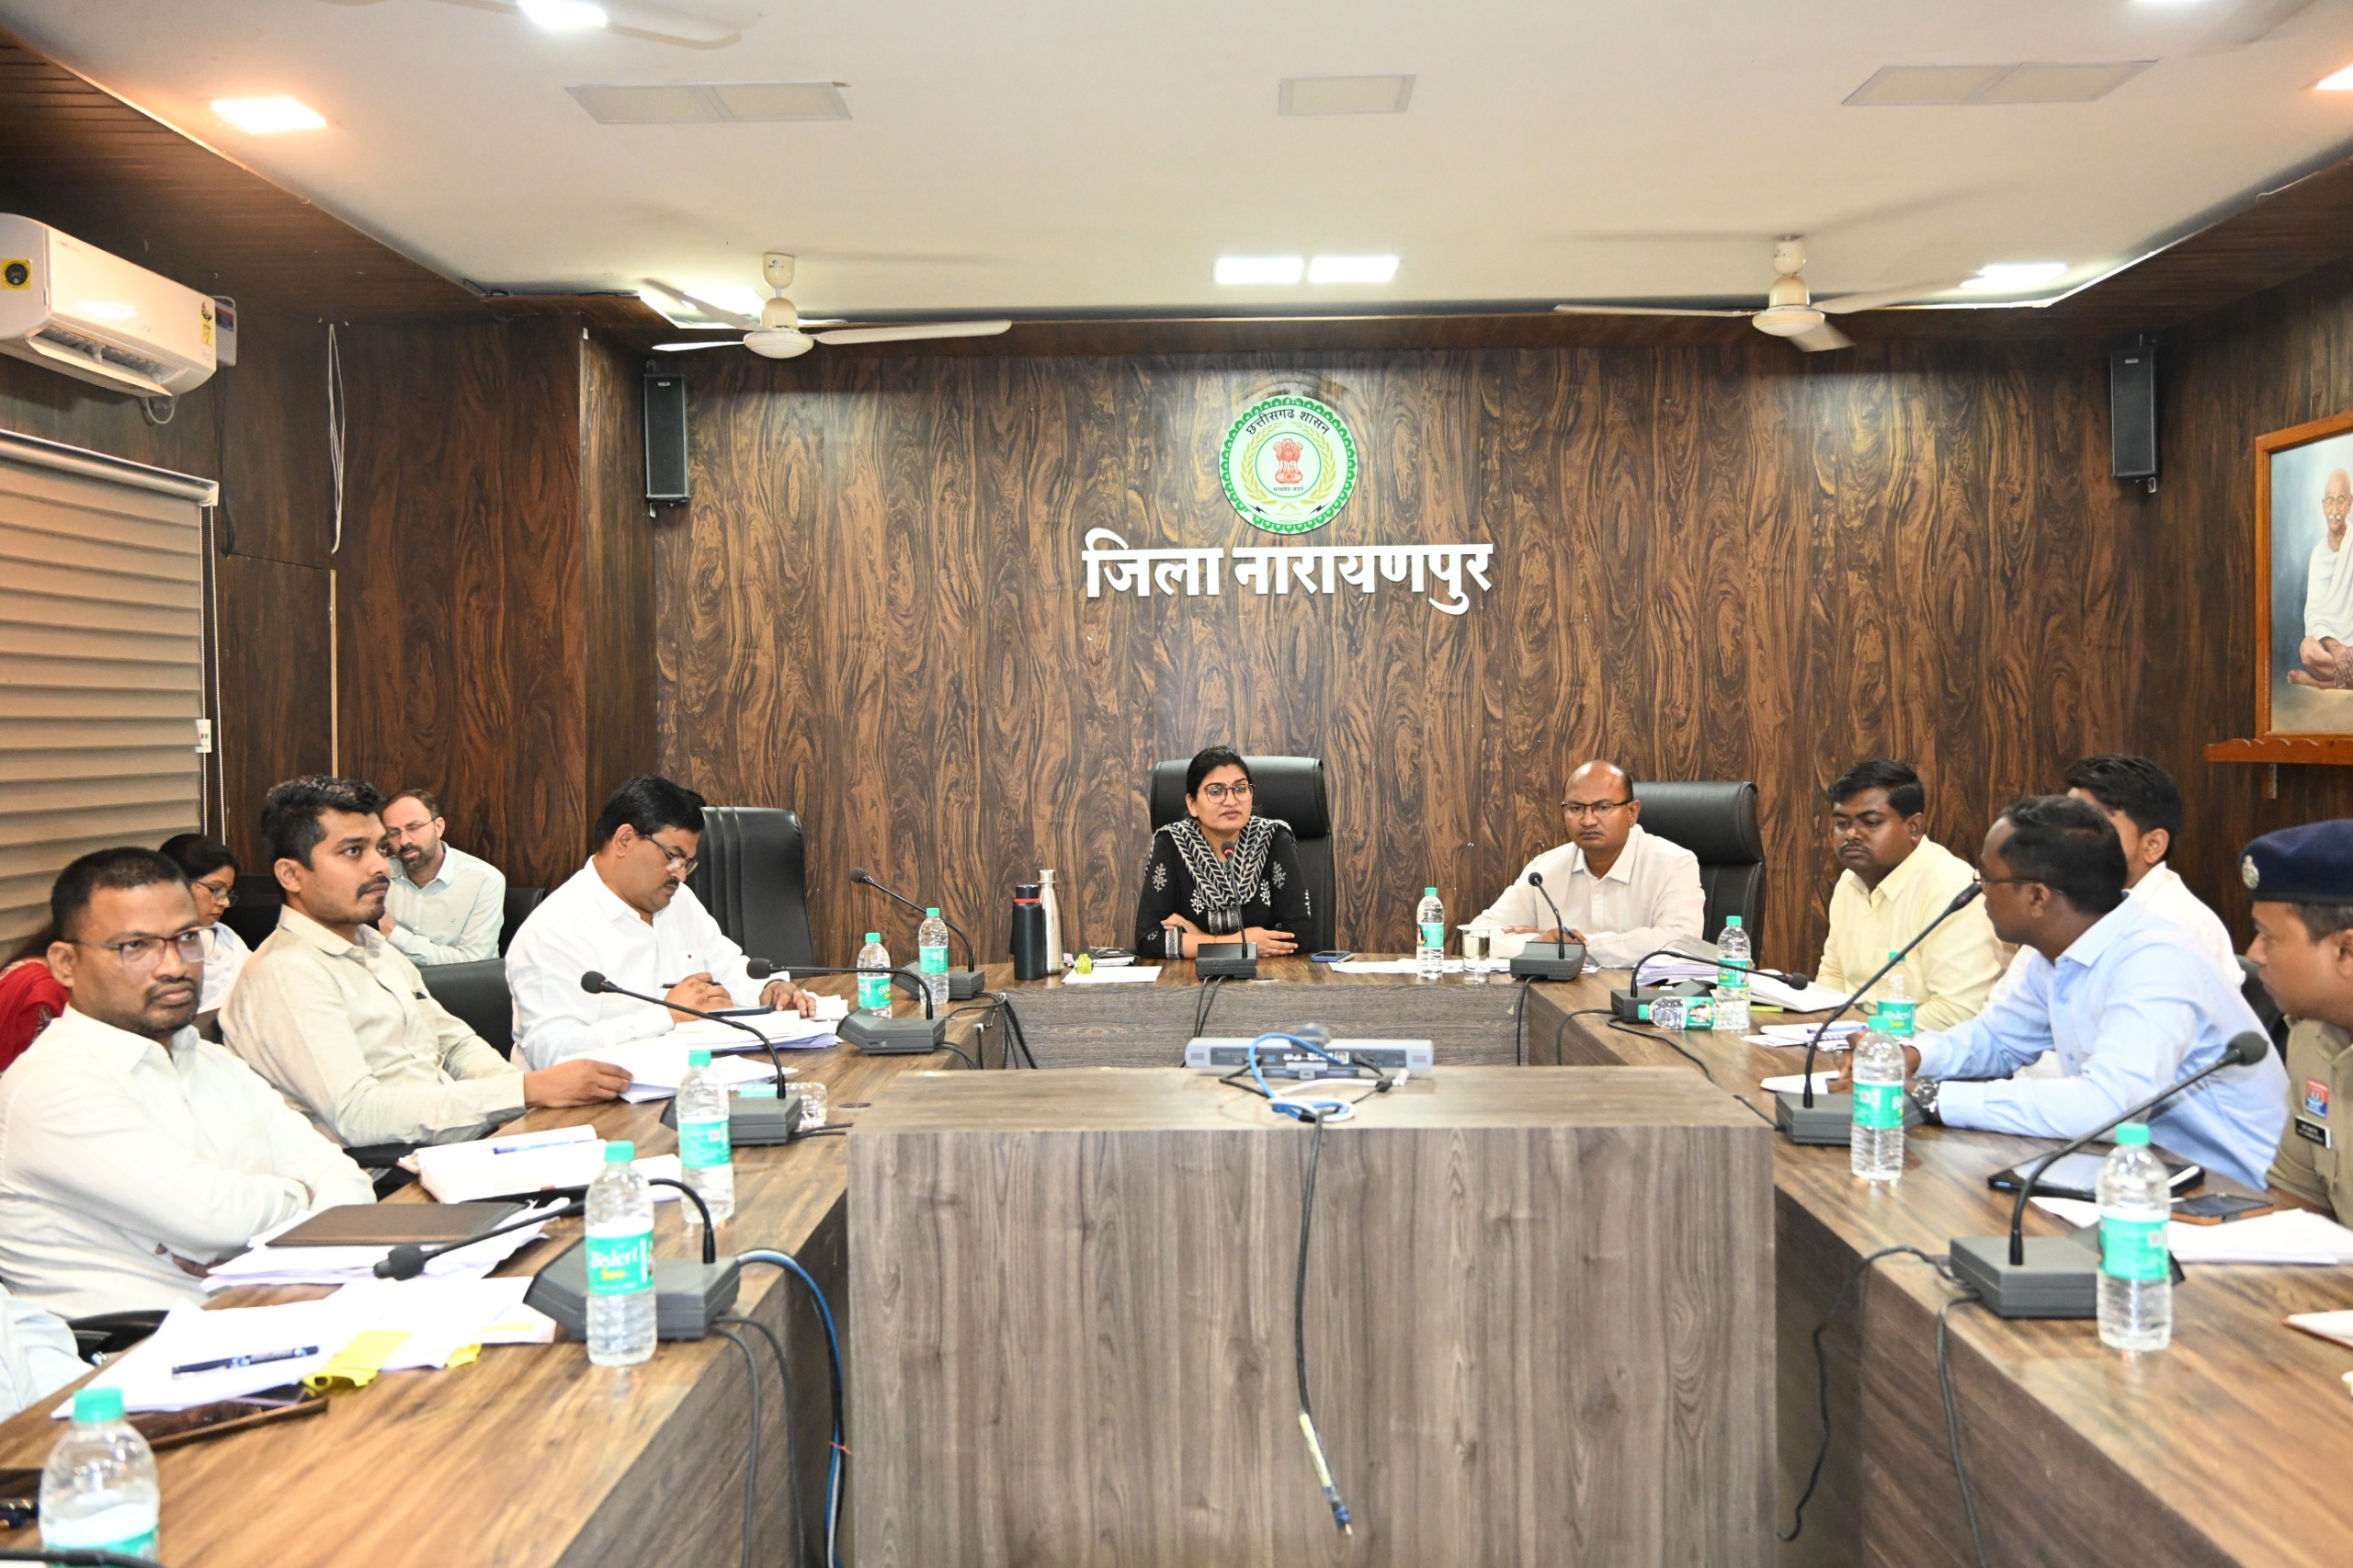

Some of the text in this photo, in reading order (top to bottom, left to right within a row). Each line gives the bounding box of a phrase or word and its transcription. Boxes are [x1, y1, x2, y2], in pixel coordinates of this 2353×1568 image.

[1300, 411, 1330, 435] शासन
[1082, 528, 1494, 616] जिला नारायणपुर
